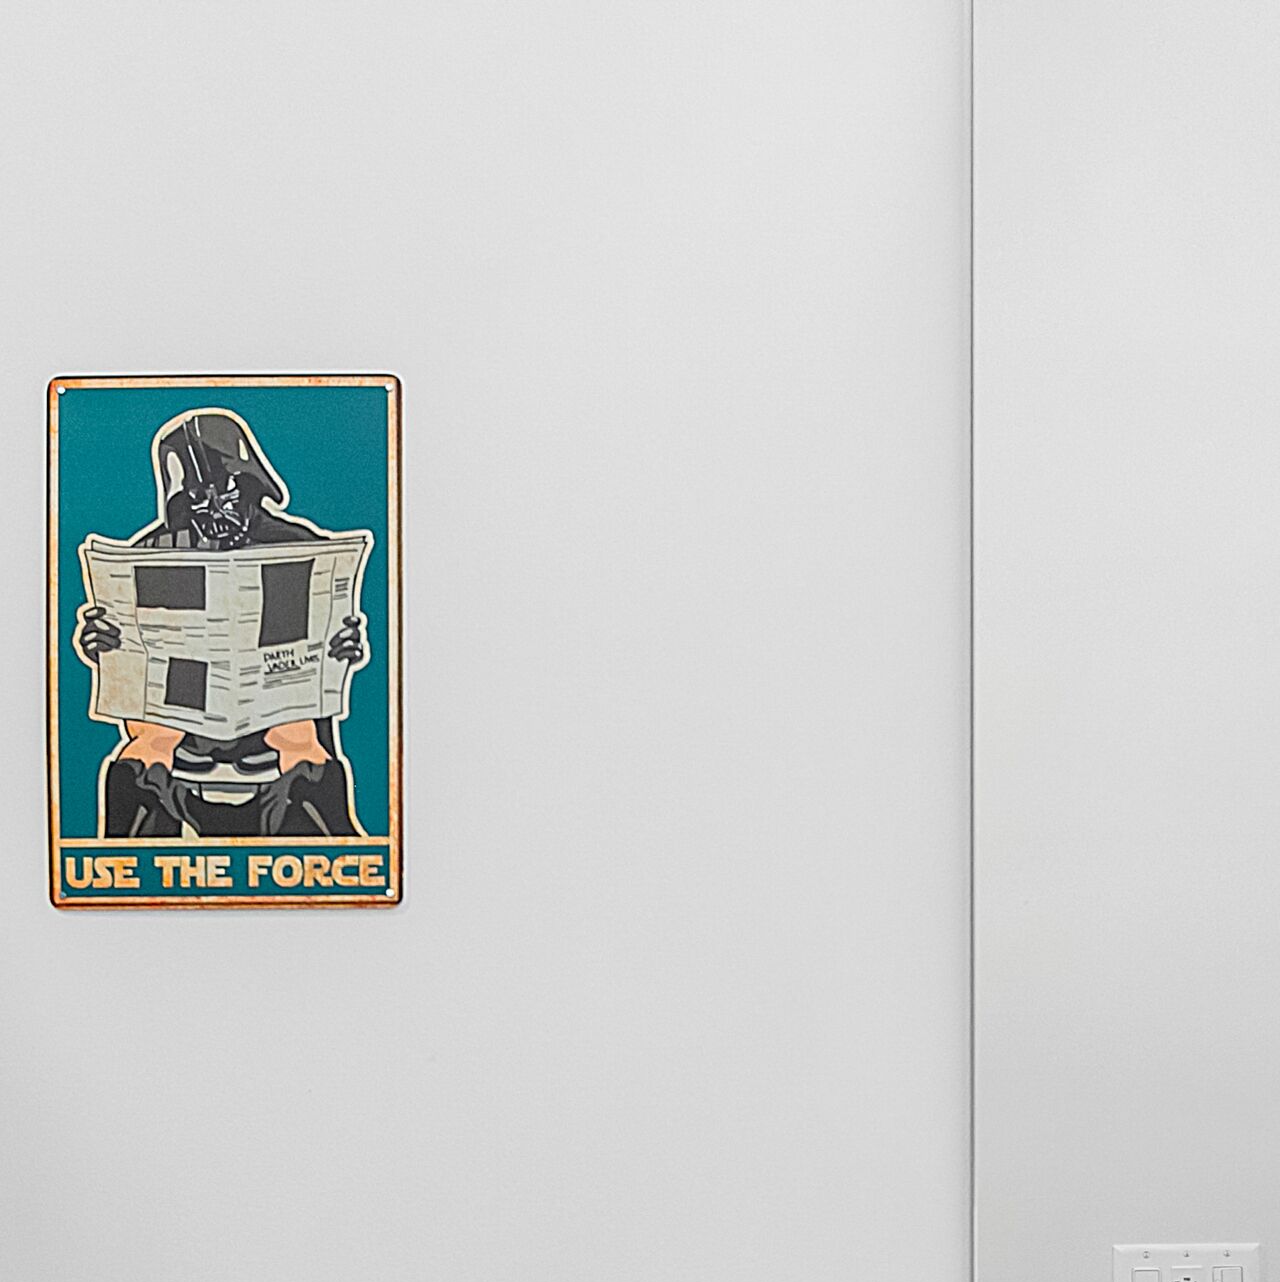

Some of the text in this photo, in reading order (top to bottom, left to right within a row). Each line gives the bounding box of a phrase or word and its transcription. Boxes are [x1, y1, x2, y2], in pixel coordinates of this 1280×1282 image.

[65, 854, 386, 888] USE THE FORCE
